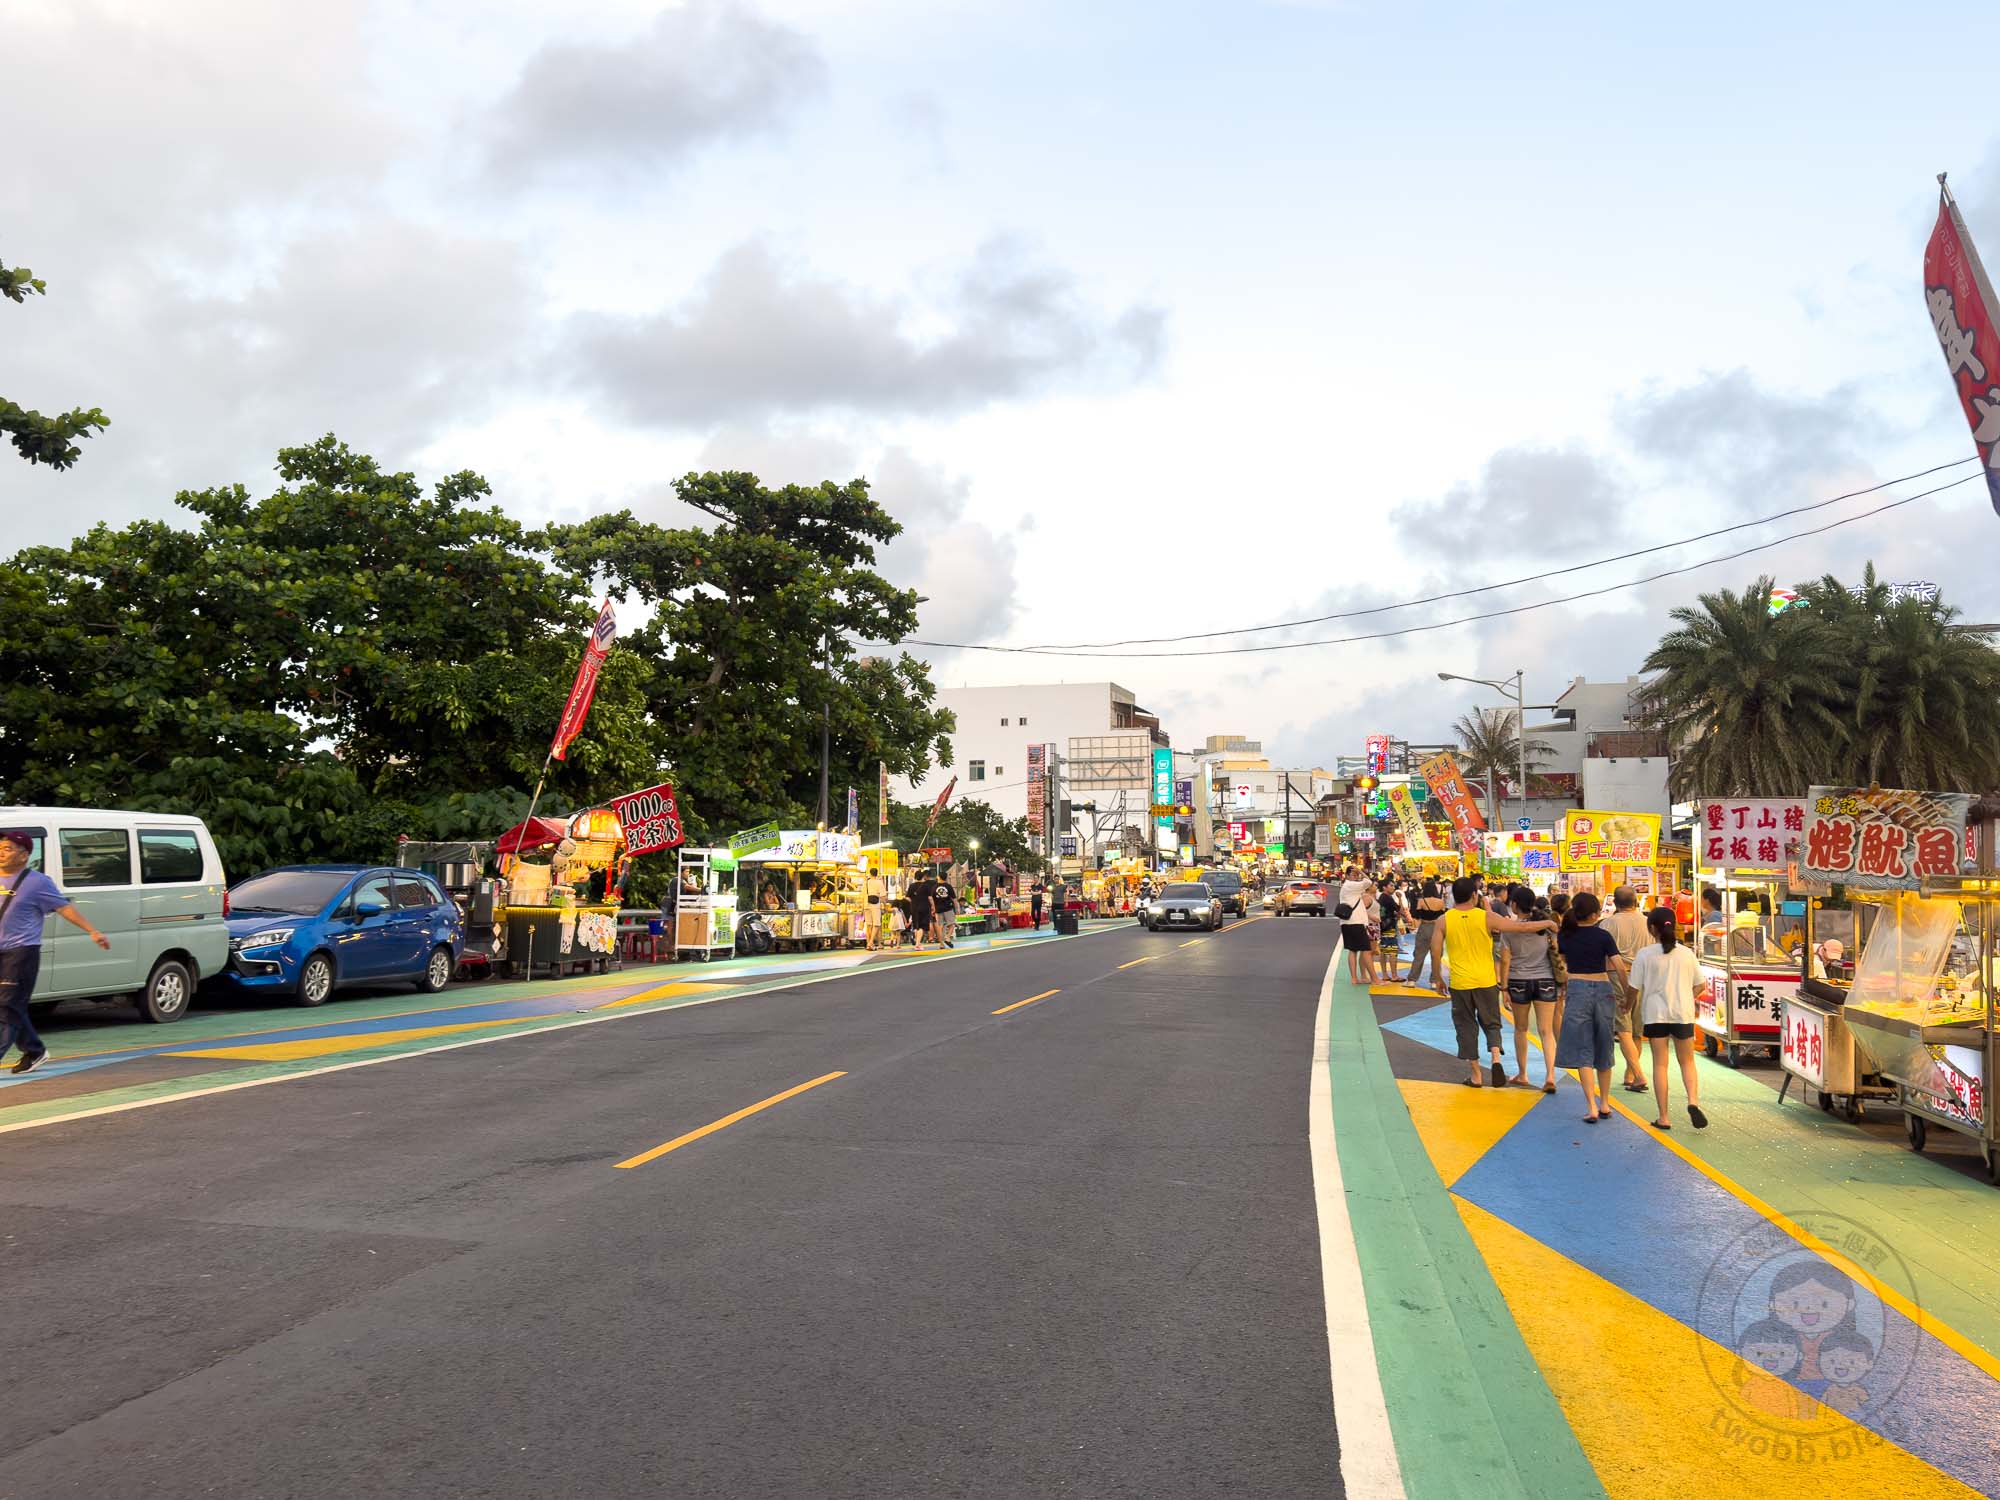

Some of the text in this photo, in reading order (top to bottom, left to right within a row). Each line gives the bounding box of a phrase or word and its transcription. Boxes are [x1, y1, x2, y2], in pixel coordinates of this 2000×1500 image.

[1706, 803, 1805, 832] 墾丁山豬
[1815, 797, 1860, 816] 瑞記
[626, 817, 680, 853] 紅茶冰
[1519, 819, 1530, 828] 26
[1568, 840, 1652, 862] 手工麻糬
[1806, 818, 1958, 877] 烤魷魚
[1783, 1015, 1822, 1076] 山豬肉
